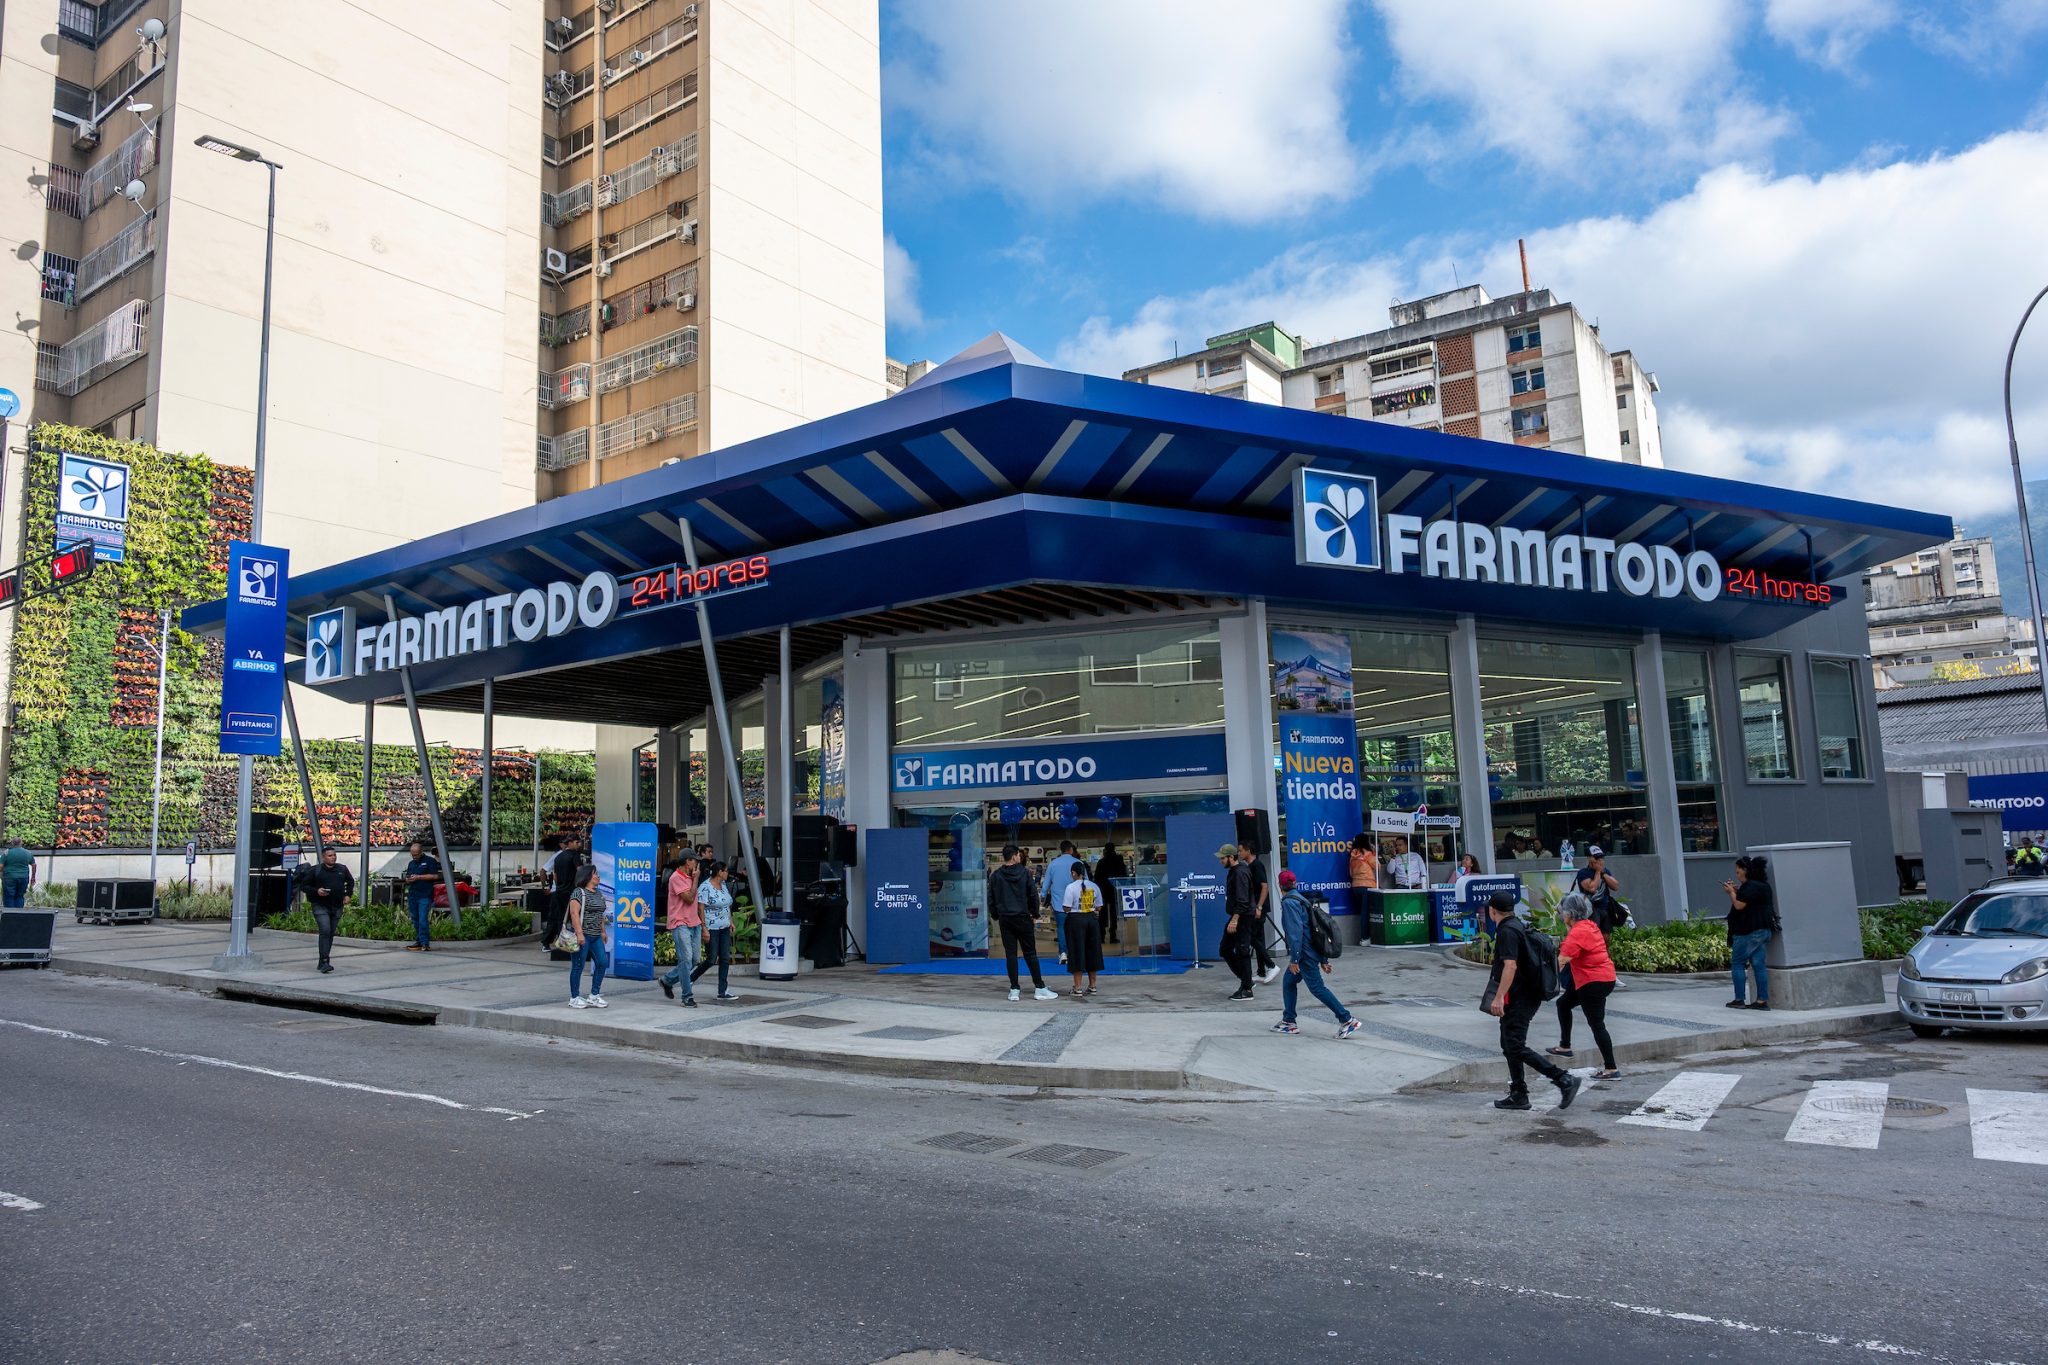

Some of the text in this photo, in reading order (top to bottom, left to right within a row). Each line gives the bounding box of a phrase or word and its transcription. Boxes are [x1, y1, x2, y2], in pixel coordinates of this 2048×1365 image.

[61, 513, 123, 531] FARMATODO
[60, 527, 122, 545] 24 horas
[1383, 513, 1831, 603] FARMATODO 24 horas
[239, 596, 277, 607] FARMATODO
[355, 556, 770, 676] FARMATODO 24 horas
[248, 649, 263, 660] YA
[234, 660, 276, 671] ABRIMOS
[1301, 735, 1345, 744] FARMATODO
[1285, 751, 1354, 774] Nueva
[927, 756, 1097, 787] FARMATODO
[1286, 777, 1356, 800] tienda
[1377, 816, 1408, 827] La Santé
[1313, 822, 1335, 837] ¡Ya
[618, 857, 652, 869] Nueva
[618, 869, 651, 882] tienda
[1311, 881, 1352, 892] esperamo
[1472, 882, 1516, 891] autofarmacia
[1390, 913, 1401, 922] La
[1402, 912, 1425, 921] Santé
